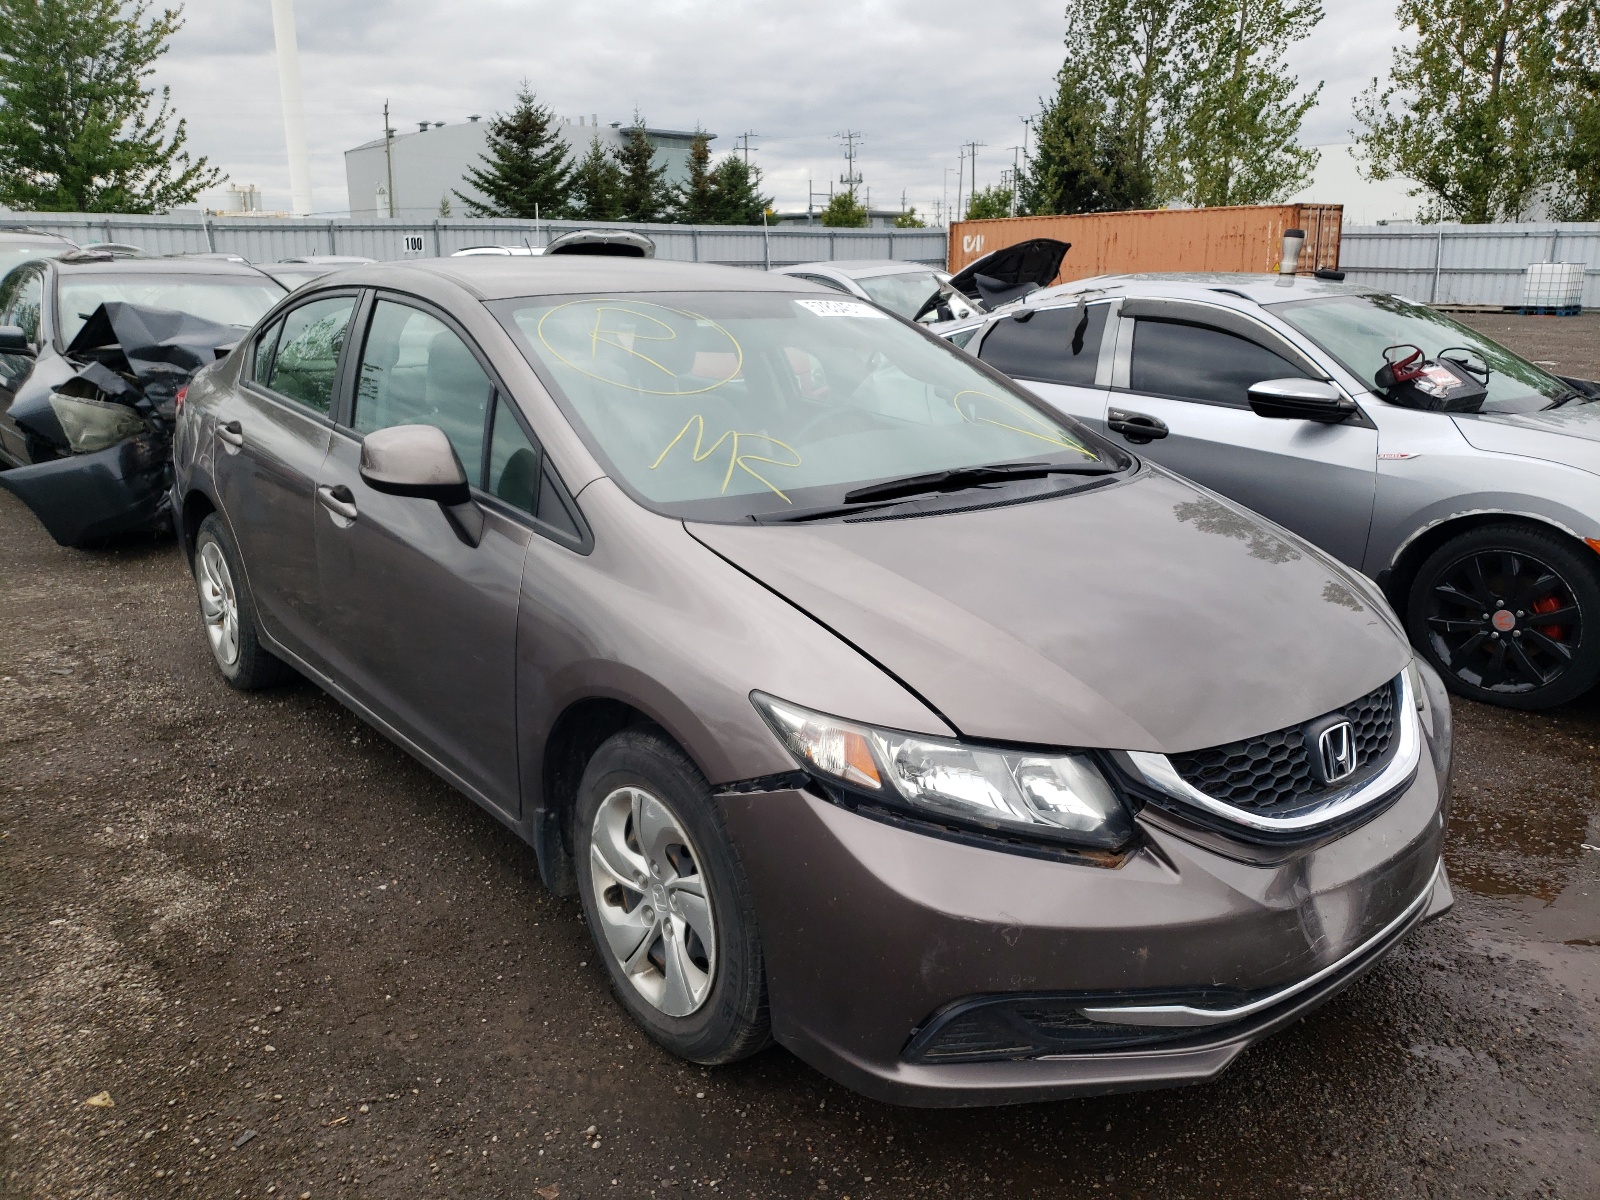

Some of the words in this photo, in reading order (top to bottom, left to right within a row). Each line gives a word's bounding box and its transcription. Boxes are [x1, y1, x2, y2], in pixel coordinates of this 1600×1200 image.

[405, 237, 422, 250] 100
[588, 308, 676, 377] R
[649, 414, 801, 504] MR
